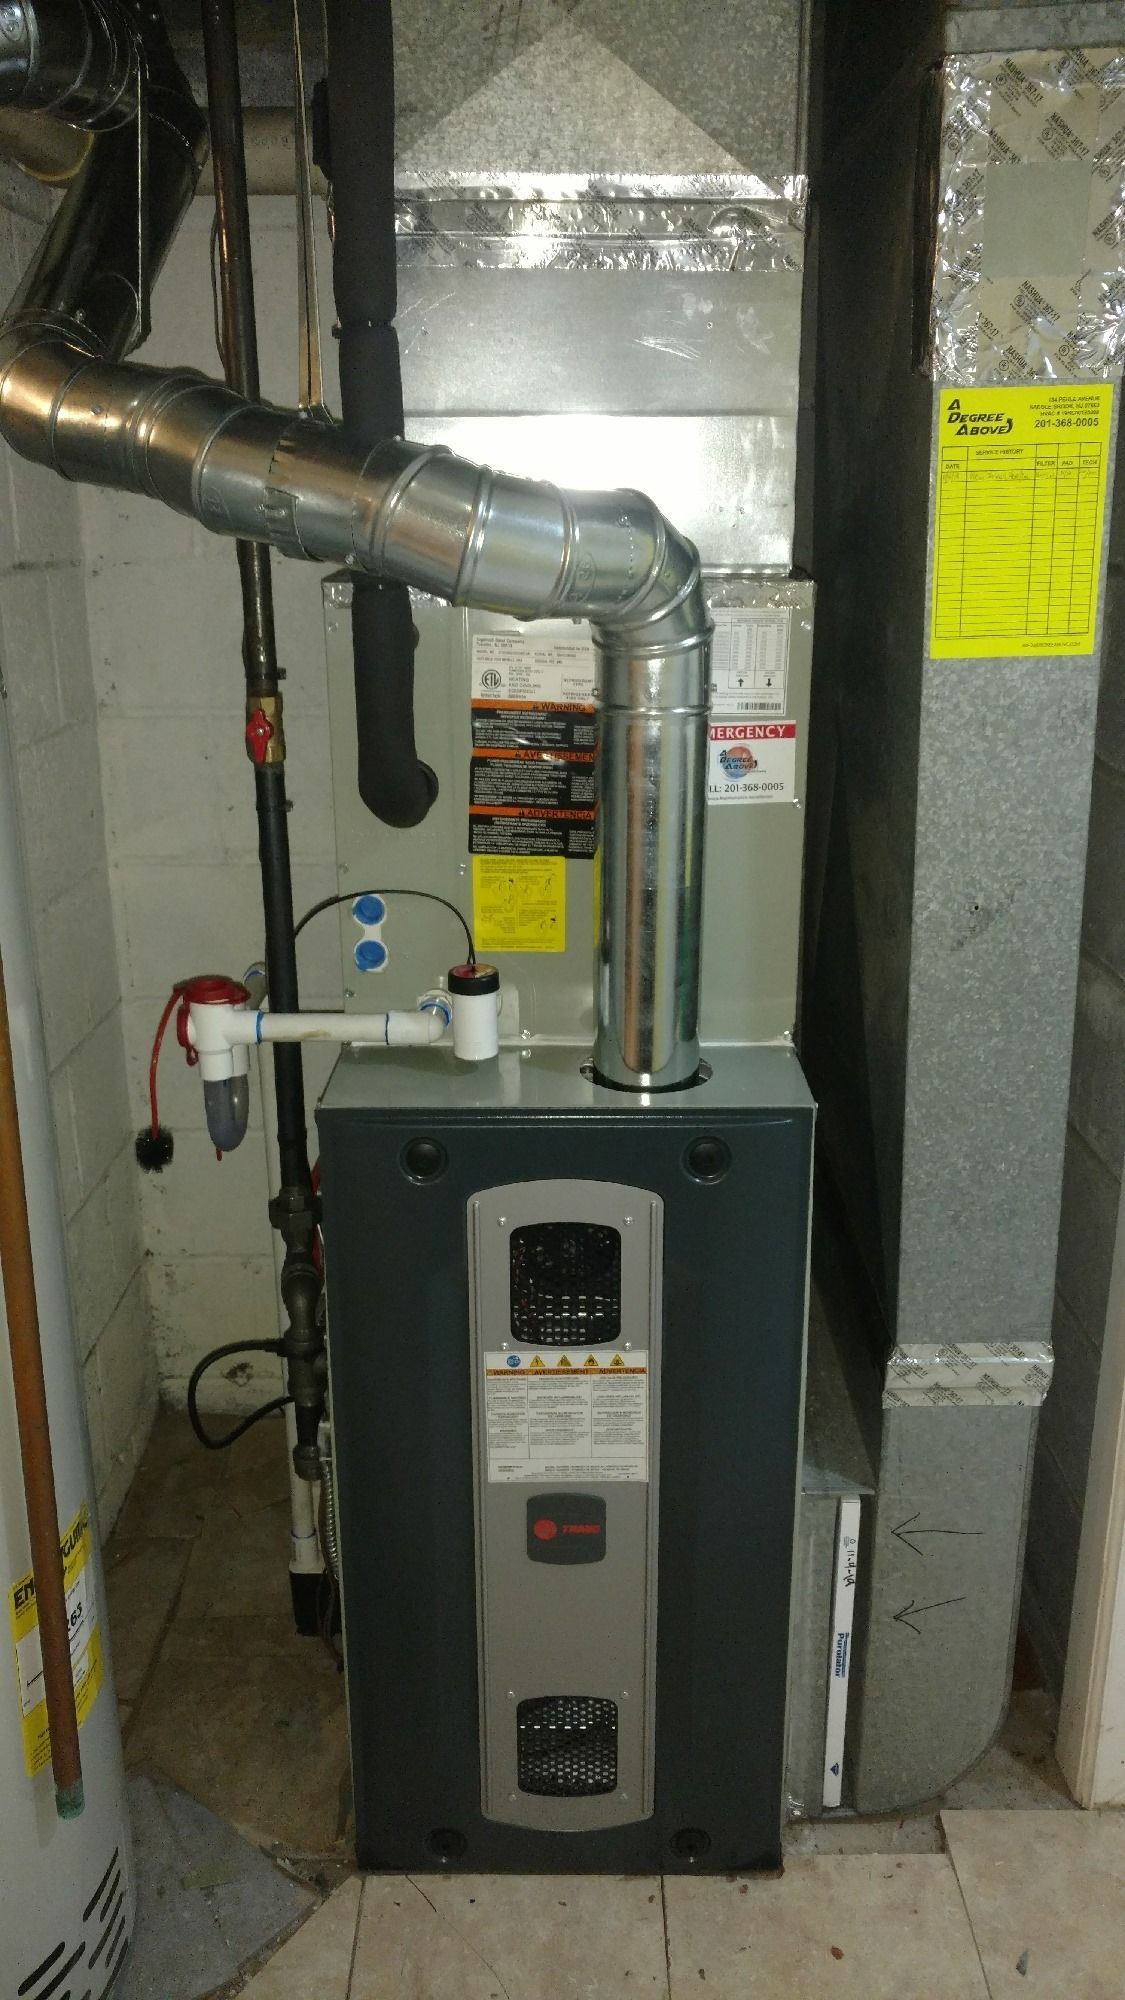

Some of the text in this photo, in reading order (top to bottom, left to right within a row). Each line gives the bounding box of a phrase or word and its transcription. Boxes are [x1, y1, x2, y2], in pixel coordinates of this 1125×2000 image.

[1021, 279, 1044, 305] NASHUA
[1005, 344, 1028, 370] NASHUA
[947, 399, 961, 411] A
[947, 412, 1005, 424] DEGREE
[1034, 417, 1099, 428] 201-368-0005
[955, 423, 1010, 436] ABOVE
[541, 703, 586, 712] WARNING
[710, 726, 785, 739] MERGENCY
[709, 782, 785, 793] LL: 201-368-0005
[527, 809, 592, 820] ADVERTENCIA
[834, 1632, 845, 1678] Purolator
